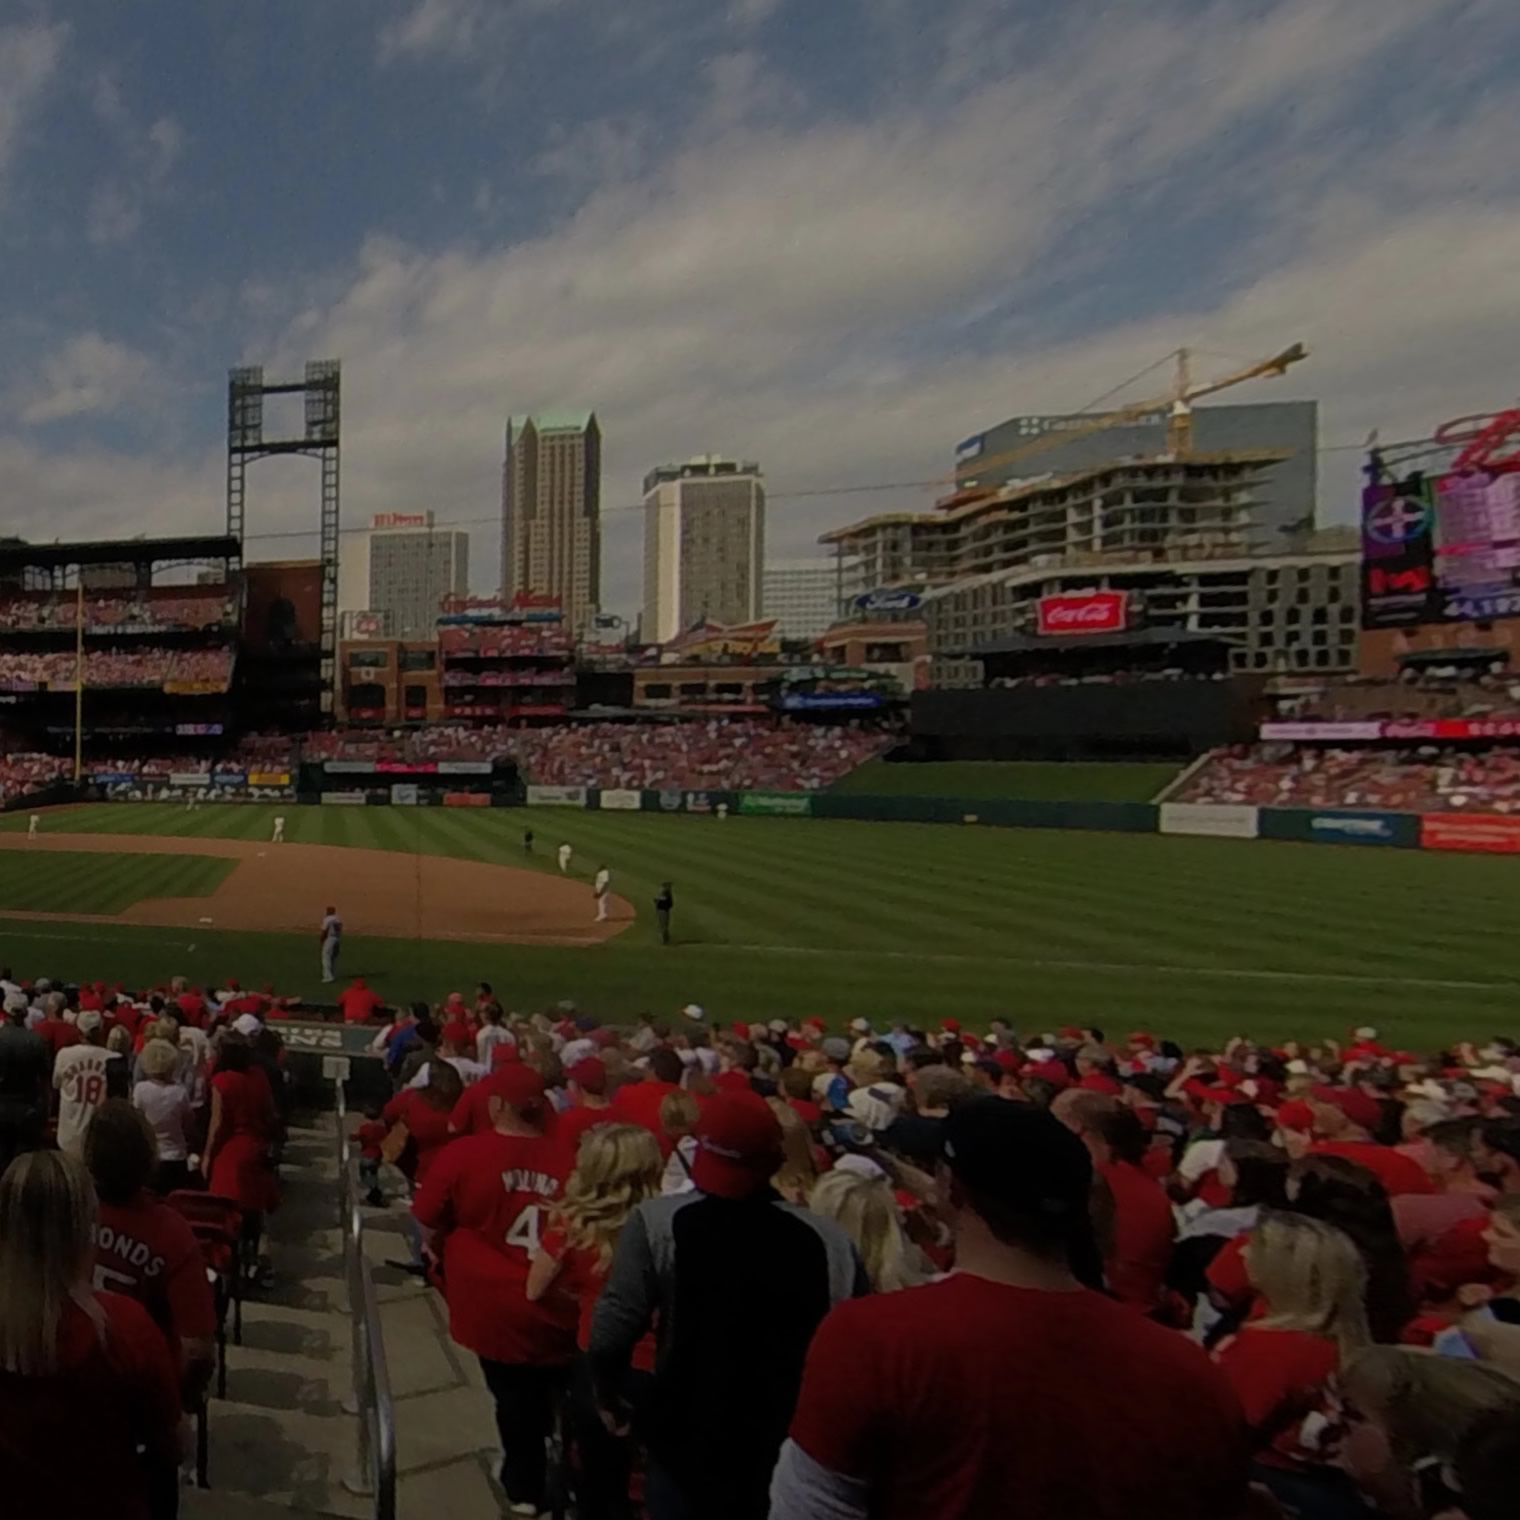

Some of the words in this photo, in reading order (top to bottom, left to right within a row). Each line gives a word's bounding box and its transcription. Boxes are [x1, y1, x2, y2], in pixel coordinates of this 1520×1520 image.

[73, 1075, 102, 1104] 18
[90, 1222, 166, 1277] ONDS
[505, 1204, 541, 1261] 4
